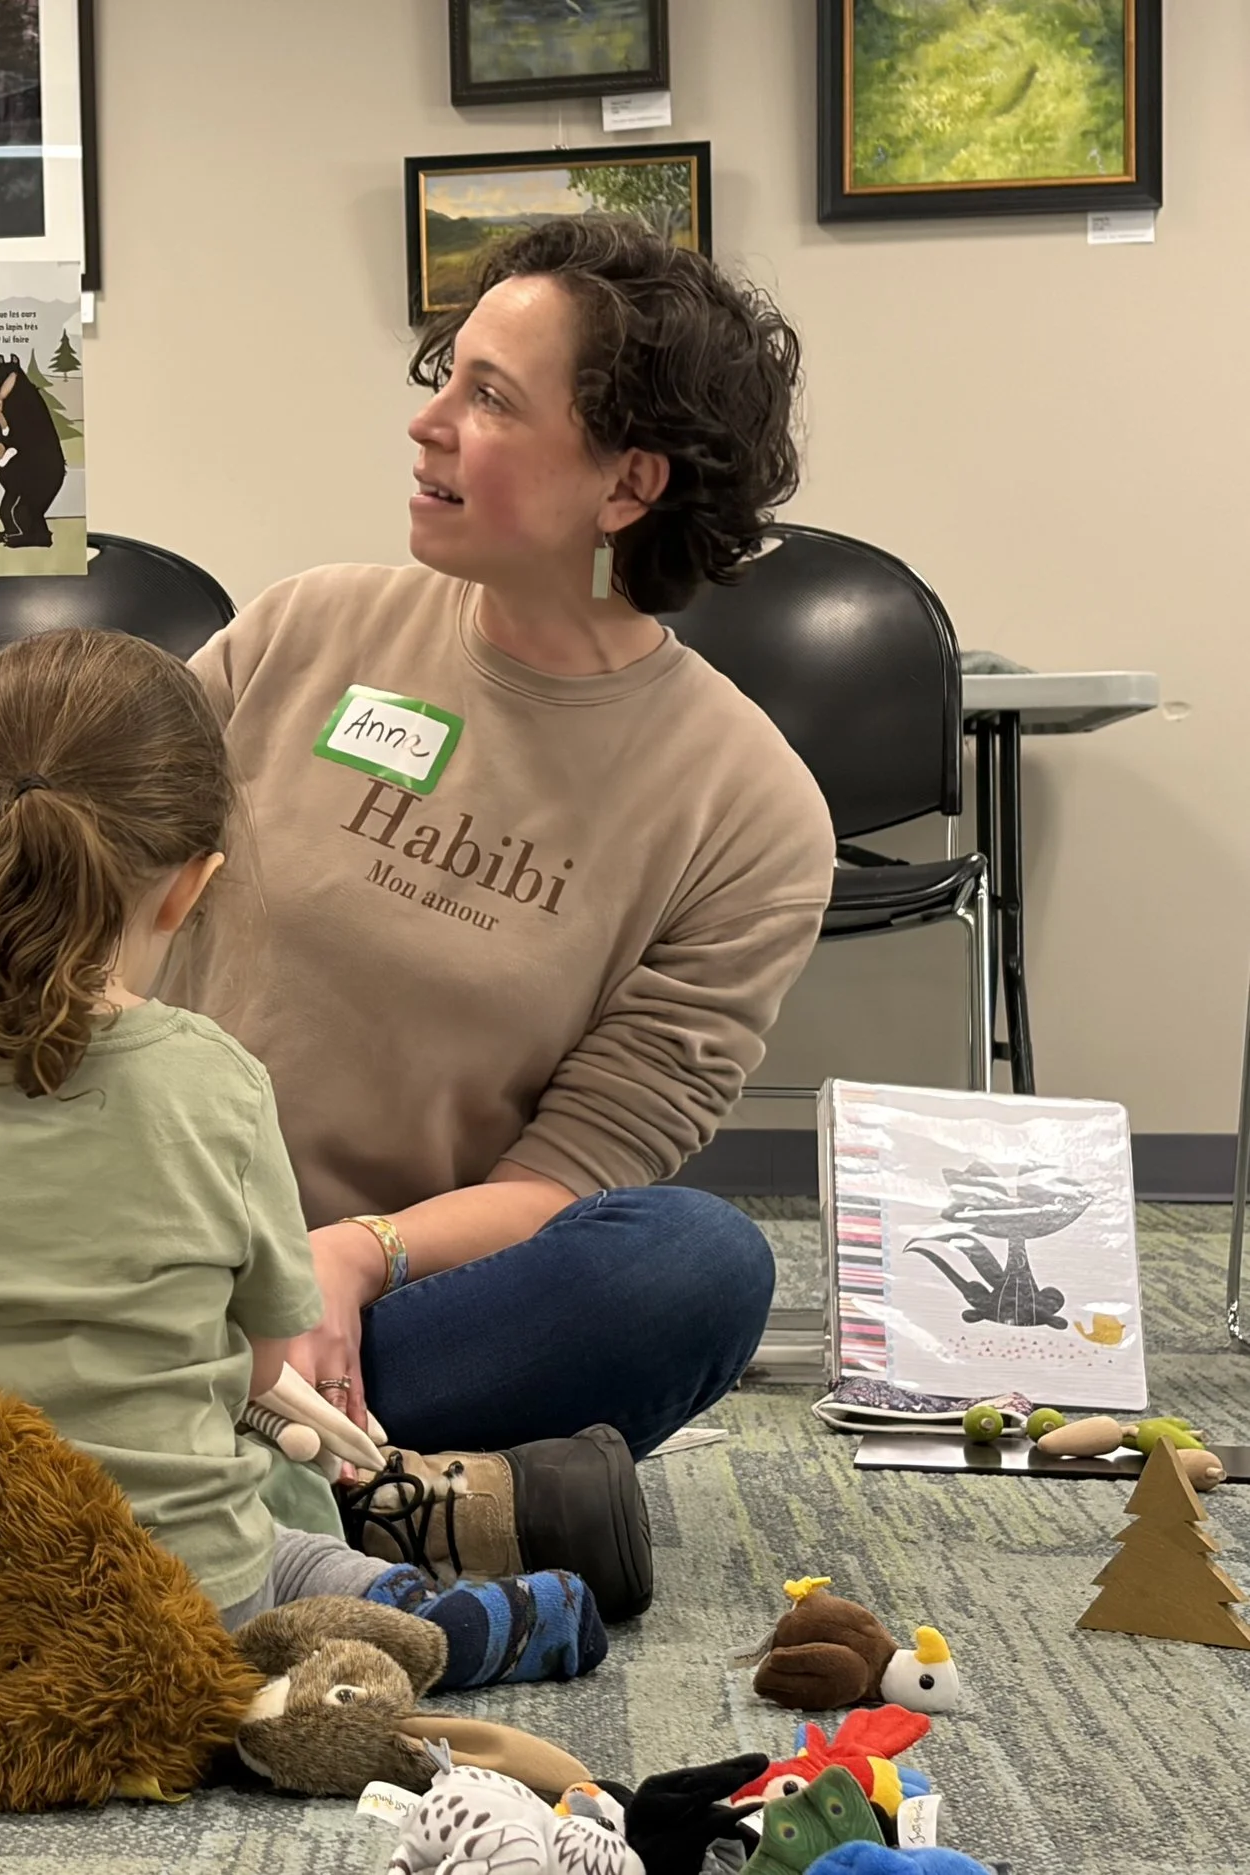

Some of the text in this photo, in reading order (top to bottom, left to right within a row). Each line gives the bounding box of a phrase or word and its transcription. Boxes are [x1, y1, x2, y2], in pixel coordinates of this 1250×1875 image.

[2, 335, 11, 343] lui
[12, 335, 29, 343] faire
[6, 323, 23, 332] lapin
[24, 323, 38, 331] très
[344, 708, 430, 757] Anne
[340, 777, 574, 916] Habibi
[364, 859, 500, 932] Mon amour
